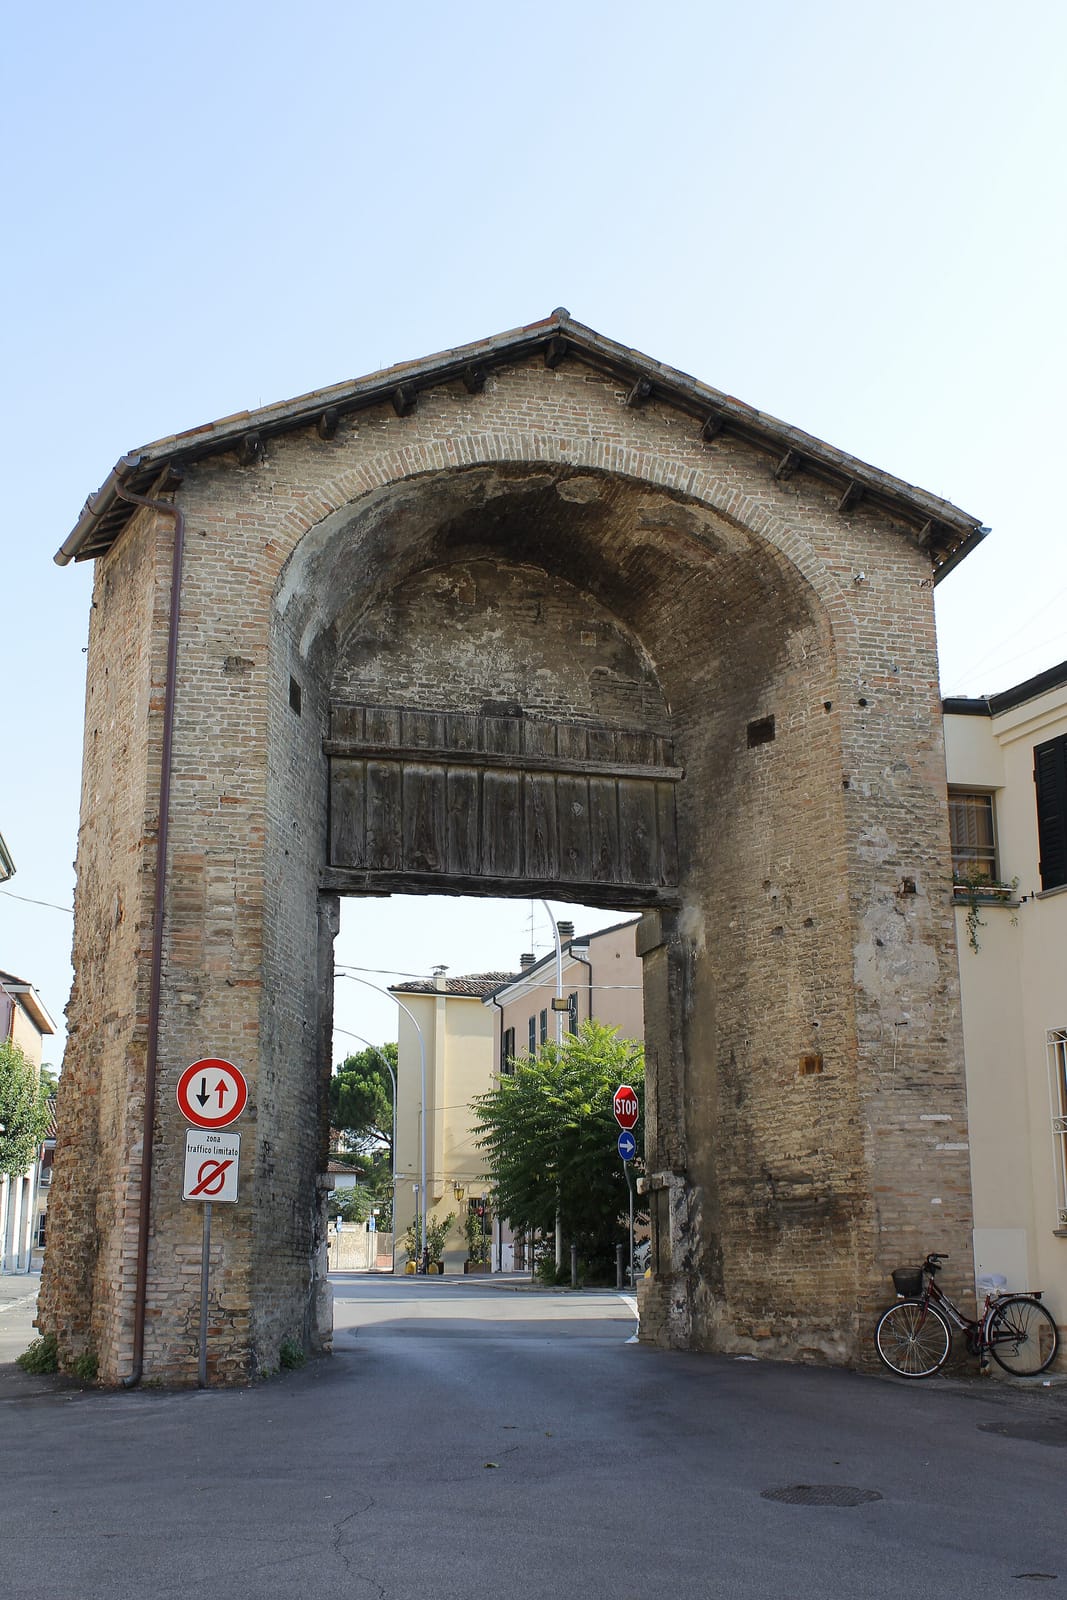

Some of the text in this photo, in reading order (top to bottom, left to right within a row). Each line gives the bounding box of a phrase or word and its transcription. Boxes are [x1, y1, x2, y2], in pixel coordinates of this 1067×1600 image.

[615, 1098, 637, 1115] STOP
[206, 1135, 221, 1143] zona
[187, 1144, 238, 1156] traffico limitato
